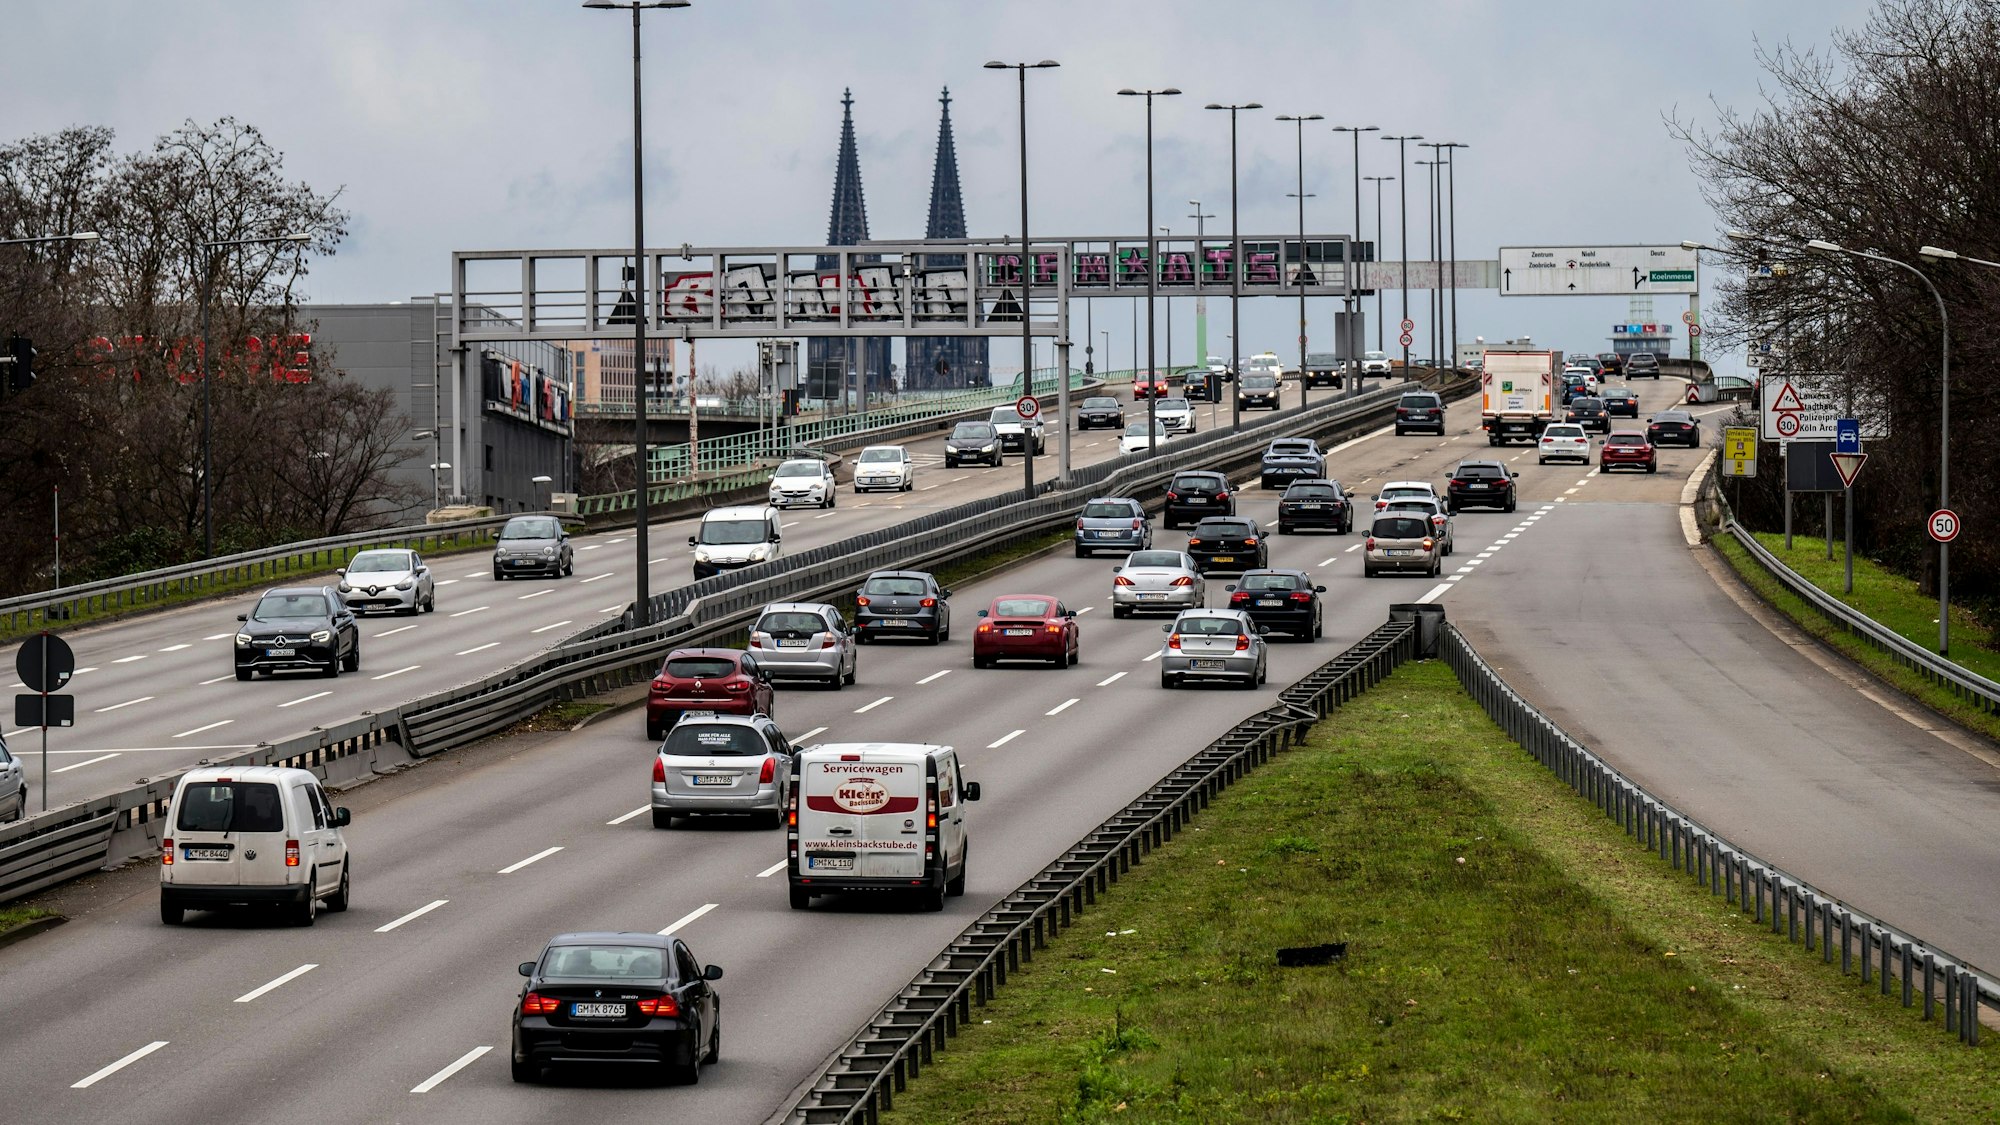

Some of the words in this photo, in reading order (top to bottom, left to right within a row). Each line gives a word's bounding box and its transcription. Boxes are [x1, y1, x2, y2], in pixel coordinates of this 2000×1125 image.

[1021, 403, 1034, 411] 30t
[1802, 402, 1838, 411] tadthaus
[1781, 420, 1796, 431] 30t
[1800, 424, 1817, 432] Köln
[1727, 430, 1755, 438] Umleitung
[1936, 518, 1953, 533] 50
[823, 763, 903, 775] Servicewagen
[698, 776, 706, 784] SU
[710, 776, 718, 784] FA
[719, 776, 731, 784] 786
[849, 798, 883, 807] Backstube
[805, 840, 918, 850] www.kleinsbackstube.de
[189, 850, 196, 858] K
[198, 850, 208, 858] HC
[210, 850, 228, 858] 8440
[813, 859, 825, 867] BM
[827, 859, 838, 867] KL
[578, 1005, 589, 1013] GM
[594, 1005, 601, 1013] K
[602, 1005, 625, 1013] 8765
